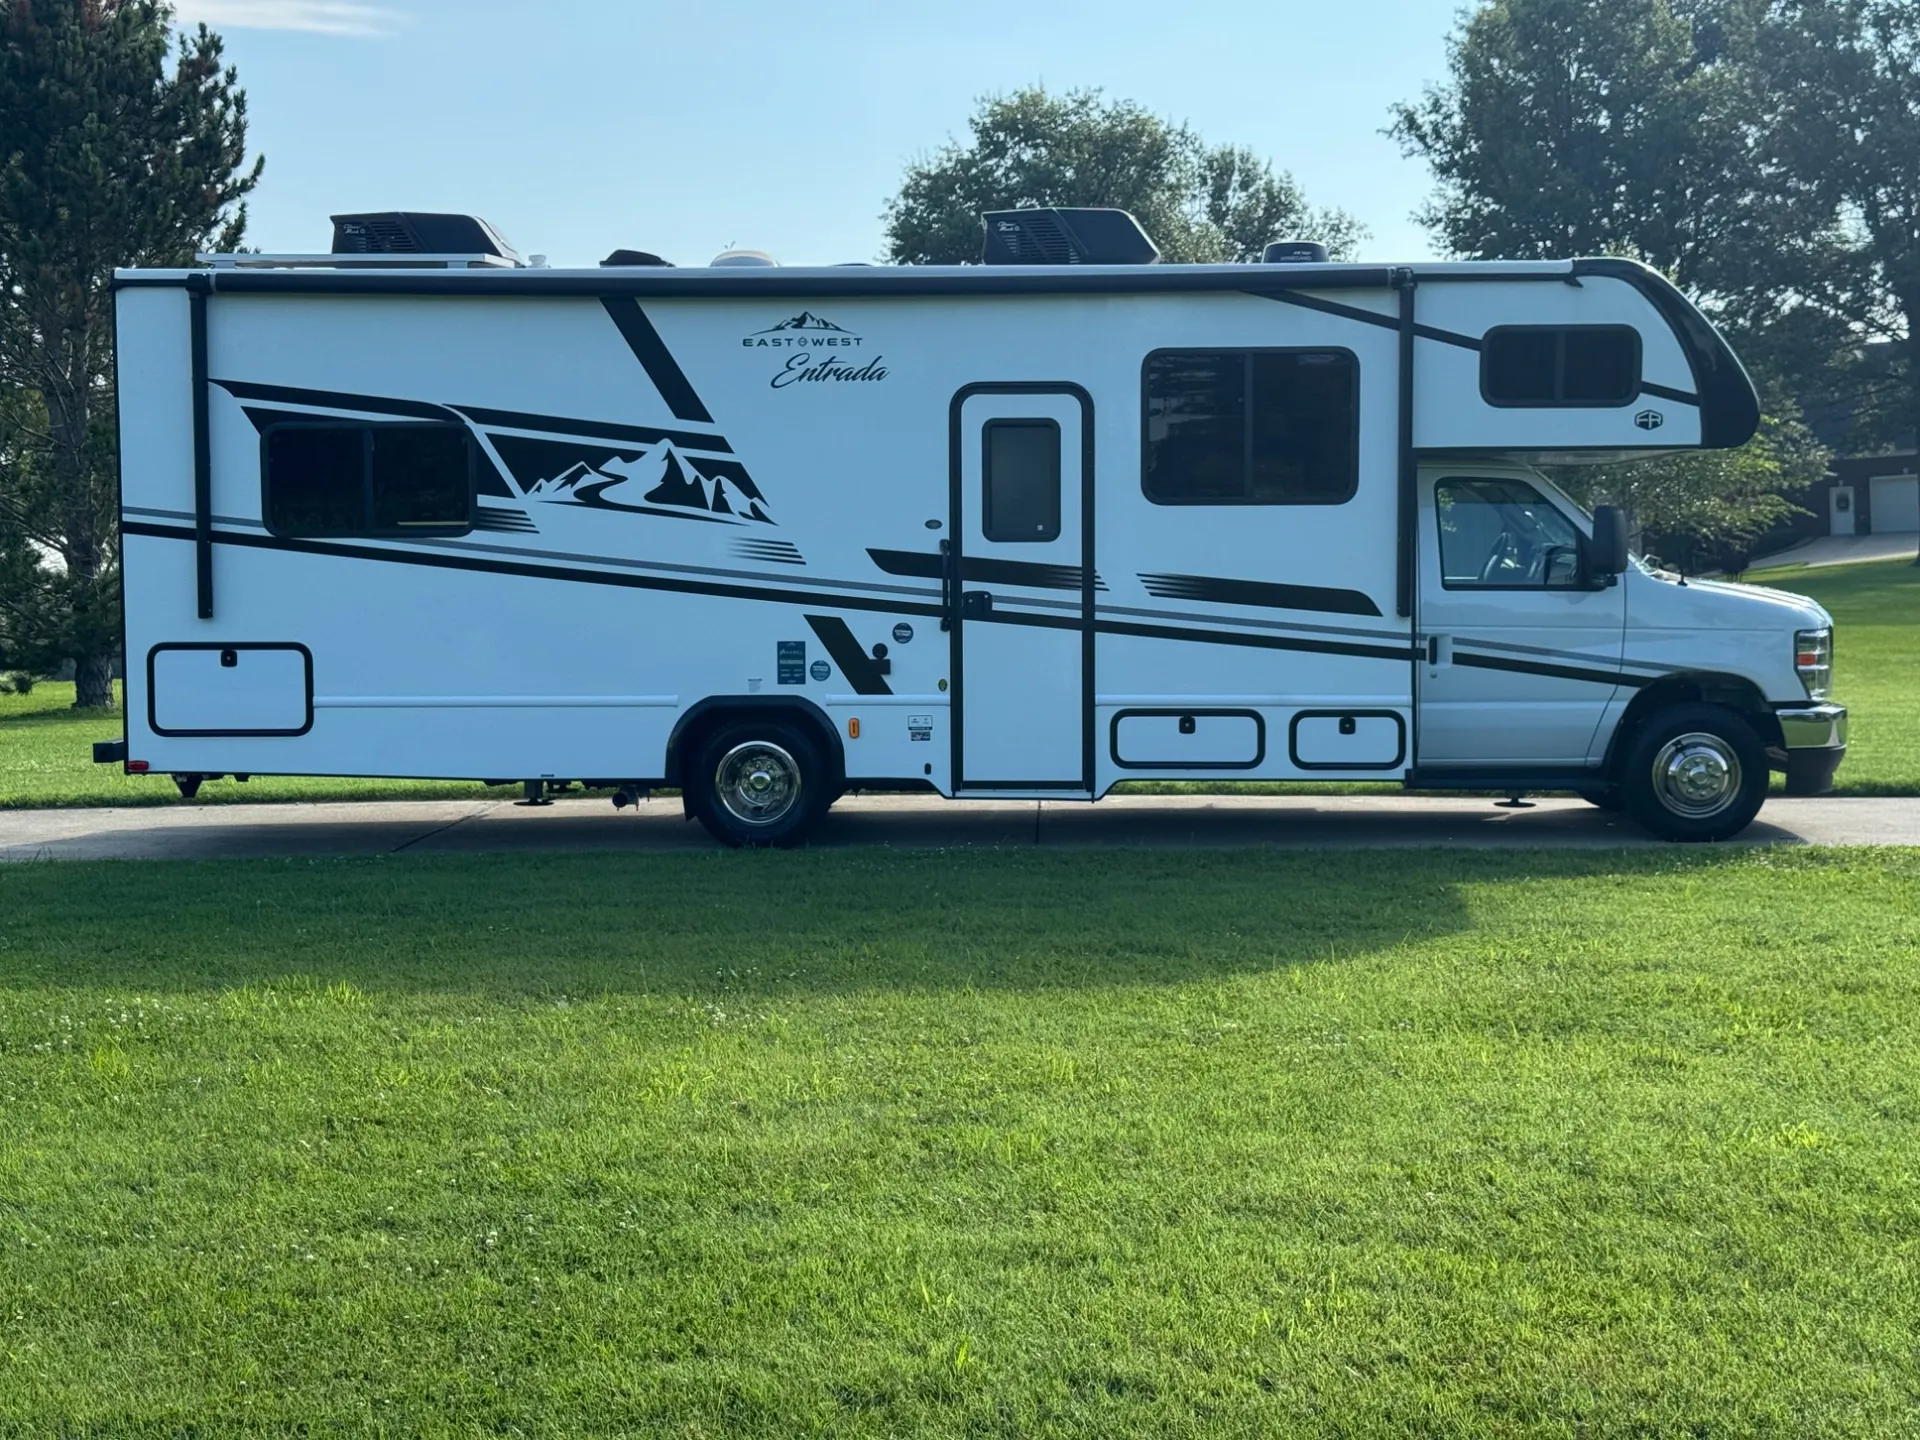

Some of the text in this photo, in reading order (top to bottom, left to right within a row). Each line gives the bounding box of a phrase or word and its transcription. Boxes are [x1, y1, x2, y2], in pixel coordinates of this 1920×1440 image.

[742, 337, 863, 347] EAST WEST
[770, 352, 891, 389] Entrada
